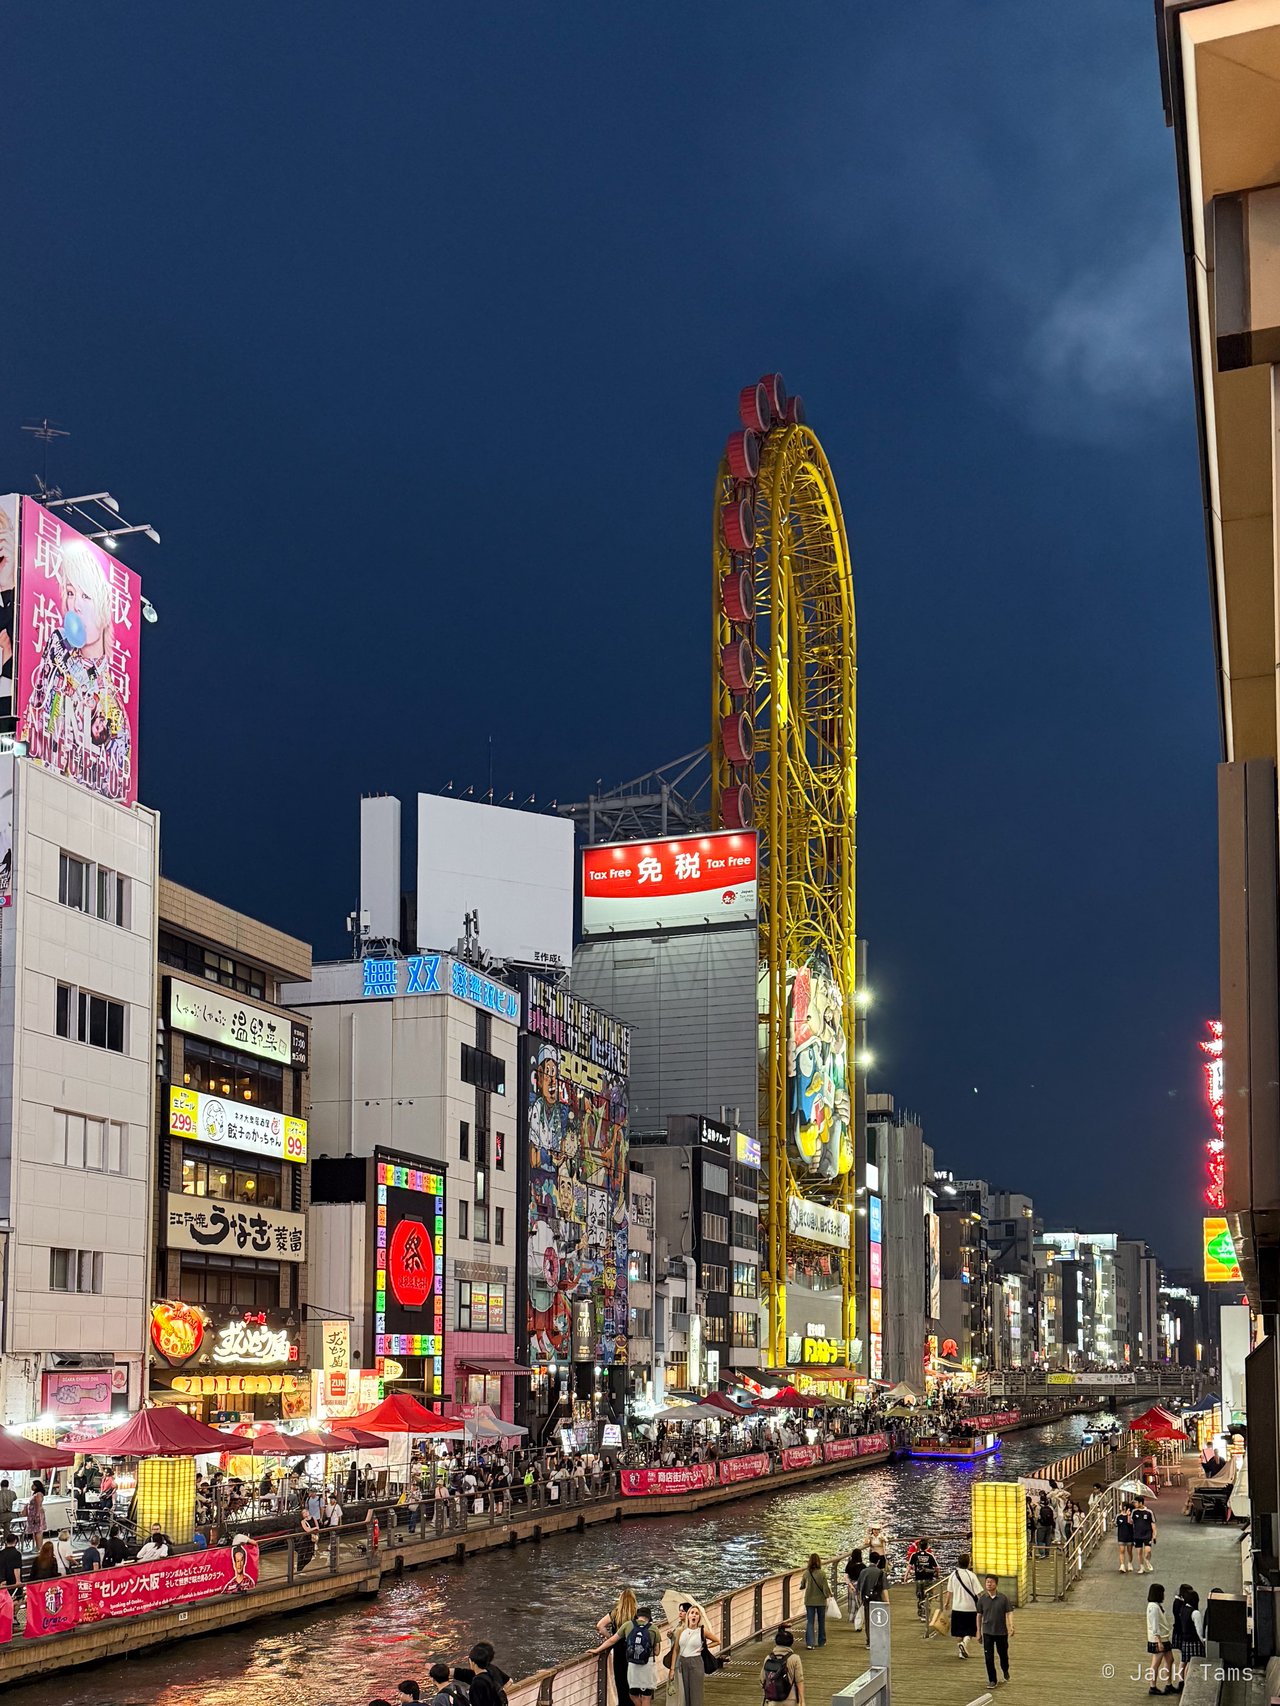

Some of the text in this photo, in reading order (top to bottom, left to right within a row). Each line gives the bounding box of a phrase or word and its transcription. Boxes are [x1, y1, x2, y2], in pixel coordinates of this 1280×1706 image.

[589, 866, 632, 881] Tax Free
[637, 852, 701, 884] 免税
[706, 855, 752, 869] Tax Free
[363, 955, 442, 997] 無双
[176, 993, 279, 1053] しゃぶしゃぶ 温野菜
[560, 1048, 604, 1093] 2025
[173, 1098, 196, 1110] 生ビール
[171, 1112, 192, 1132] 299
[227, 1122, 282, 1147] 餃子のかっちゃん
[287, 1136, 303, 1156] 99
[169, 1204, 303, 1252] 江戸焼 うなぎ 菱富
[213, 1320, 290, 1364] ずんどう屋
[326, 1331, 346, 1368] ずんどう屋
[331, 1379, 345, 1387] ZUN
